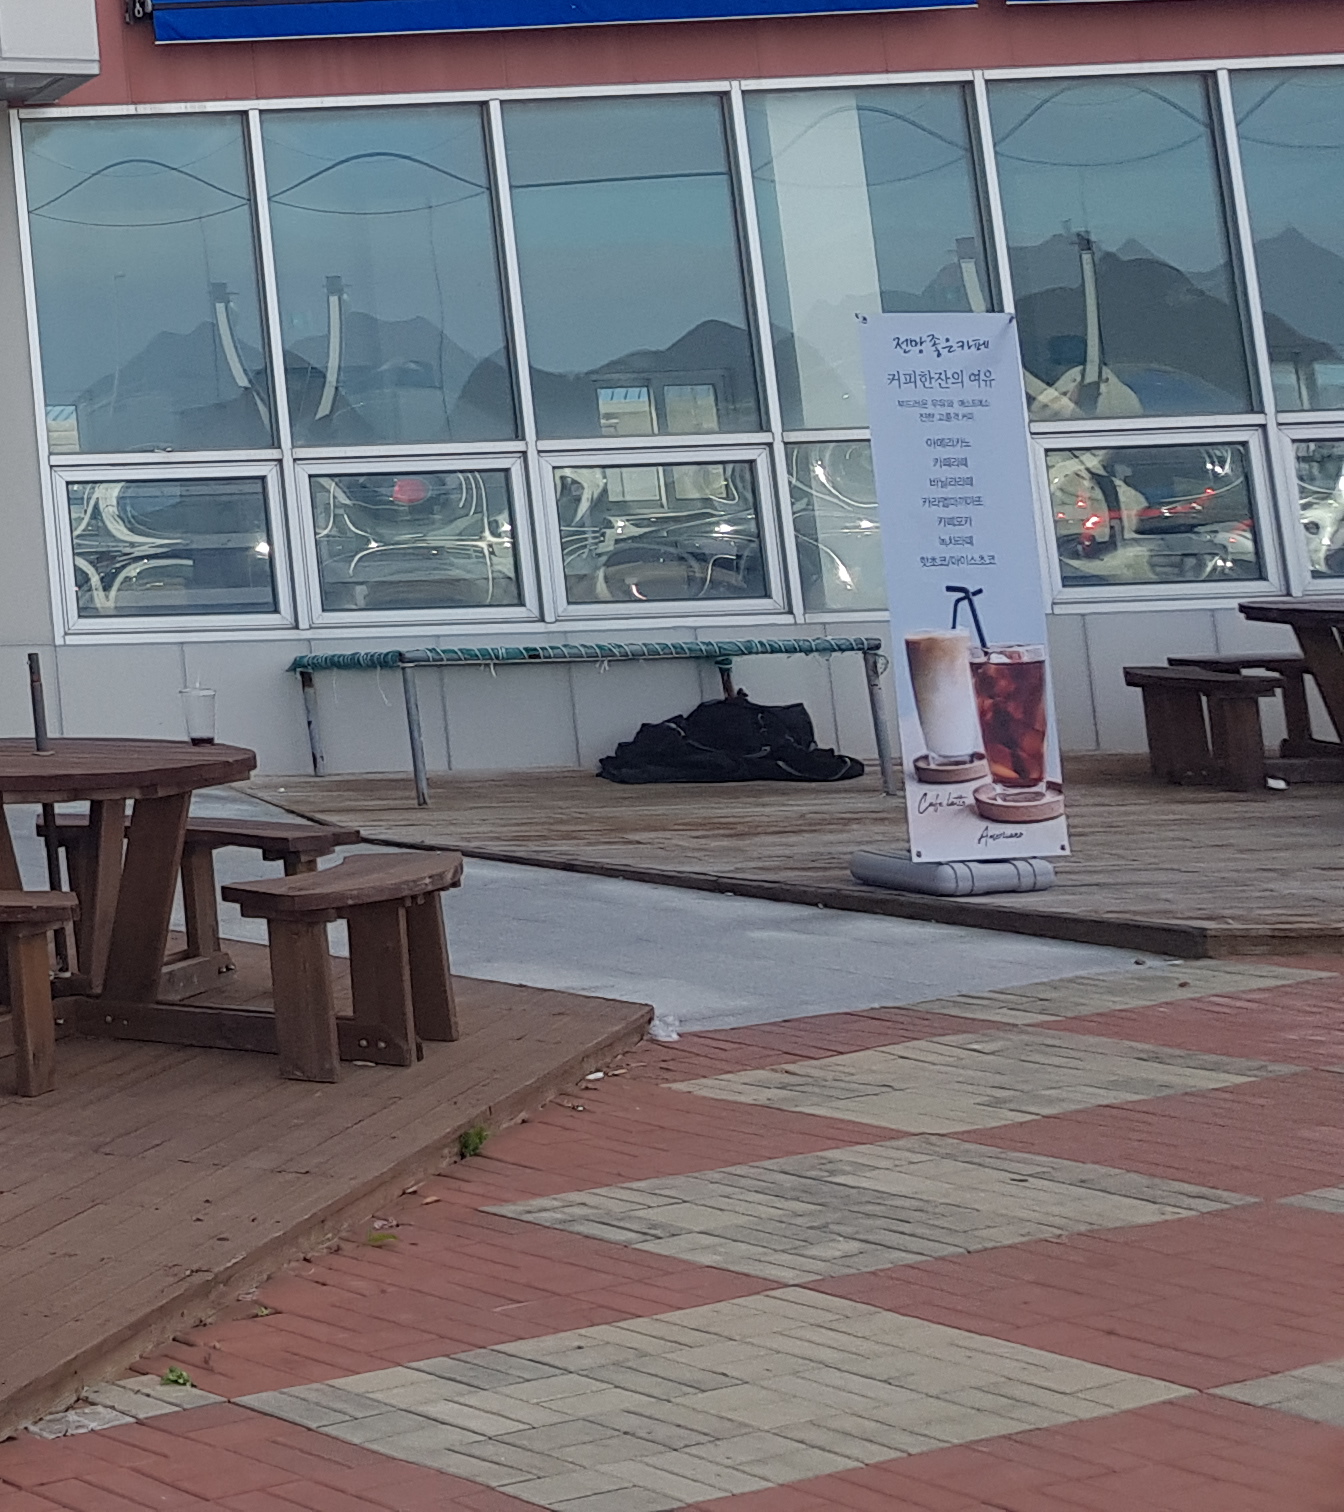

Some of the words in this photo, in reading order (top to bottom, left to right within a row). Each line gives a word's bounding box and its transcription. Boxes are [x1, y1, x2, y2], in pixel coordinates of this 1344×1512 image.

[887, 369, 964, 389] 커피한잔의
[968, 369, 996, 389] 여유
[925, 437, 972, 449] 아메리카노
